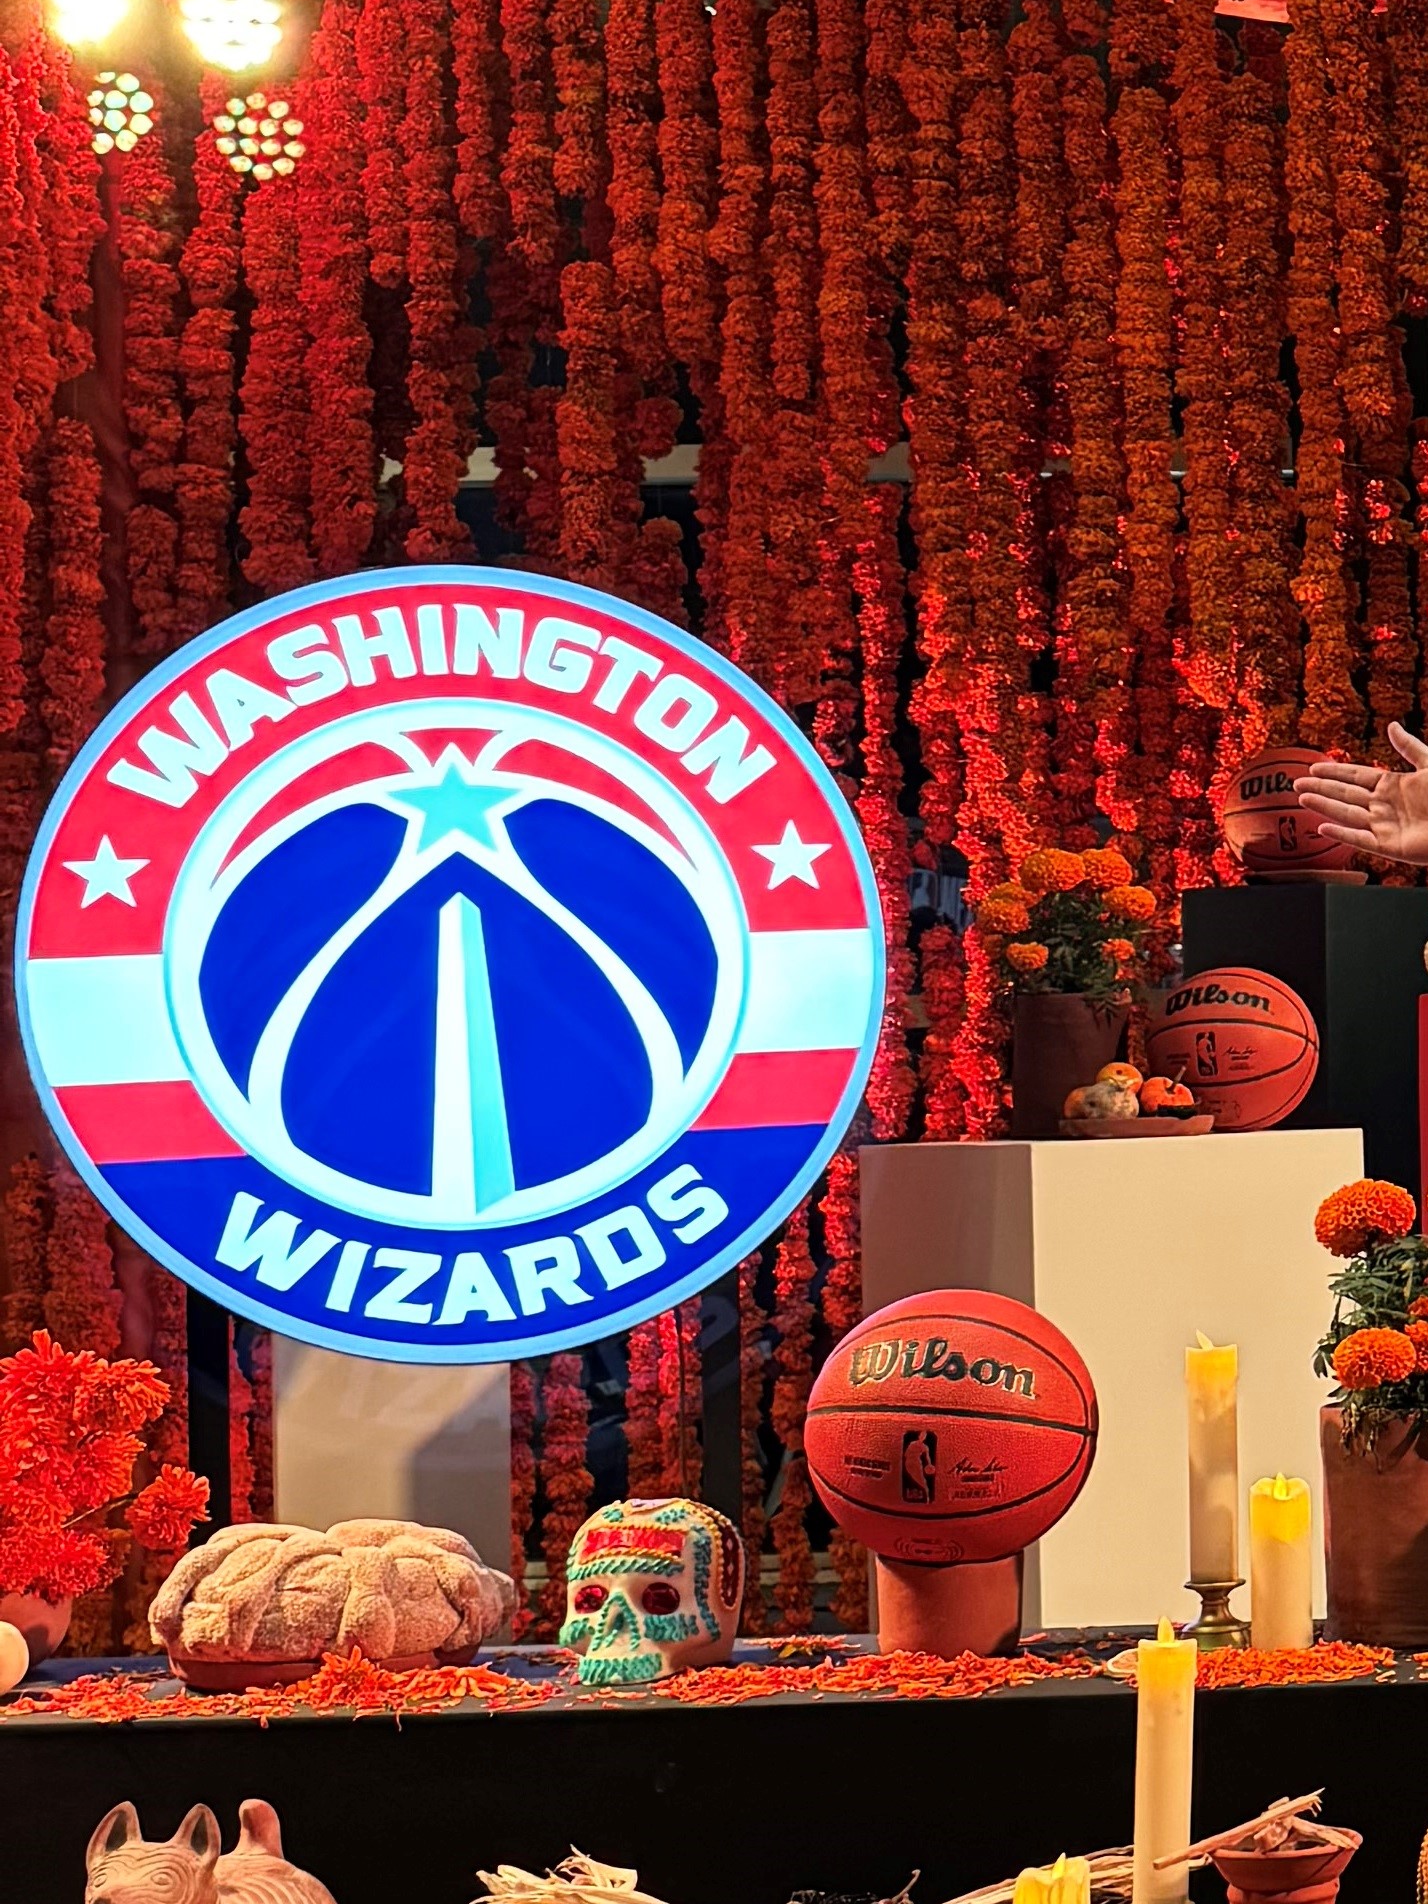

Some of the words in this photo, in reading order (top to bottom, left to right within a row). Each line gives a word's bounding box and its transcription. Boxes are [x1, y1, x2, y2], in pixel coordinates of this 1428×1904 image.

[107, 603, 777, 810] WASHINGTON
[1240, 771, 1295, 801] Wils
[1165, 983, 1270, 1016] Wilson
[214, 1163, 730, 1328] WIZARDS
[848, 1336, 1037, 1401] Wilson
